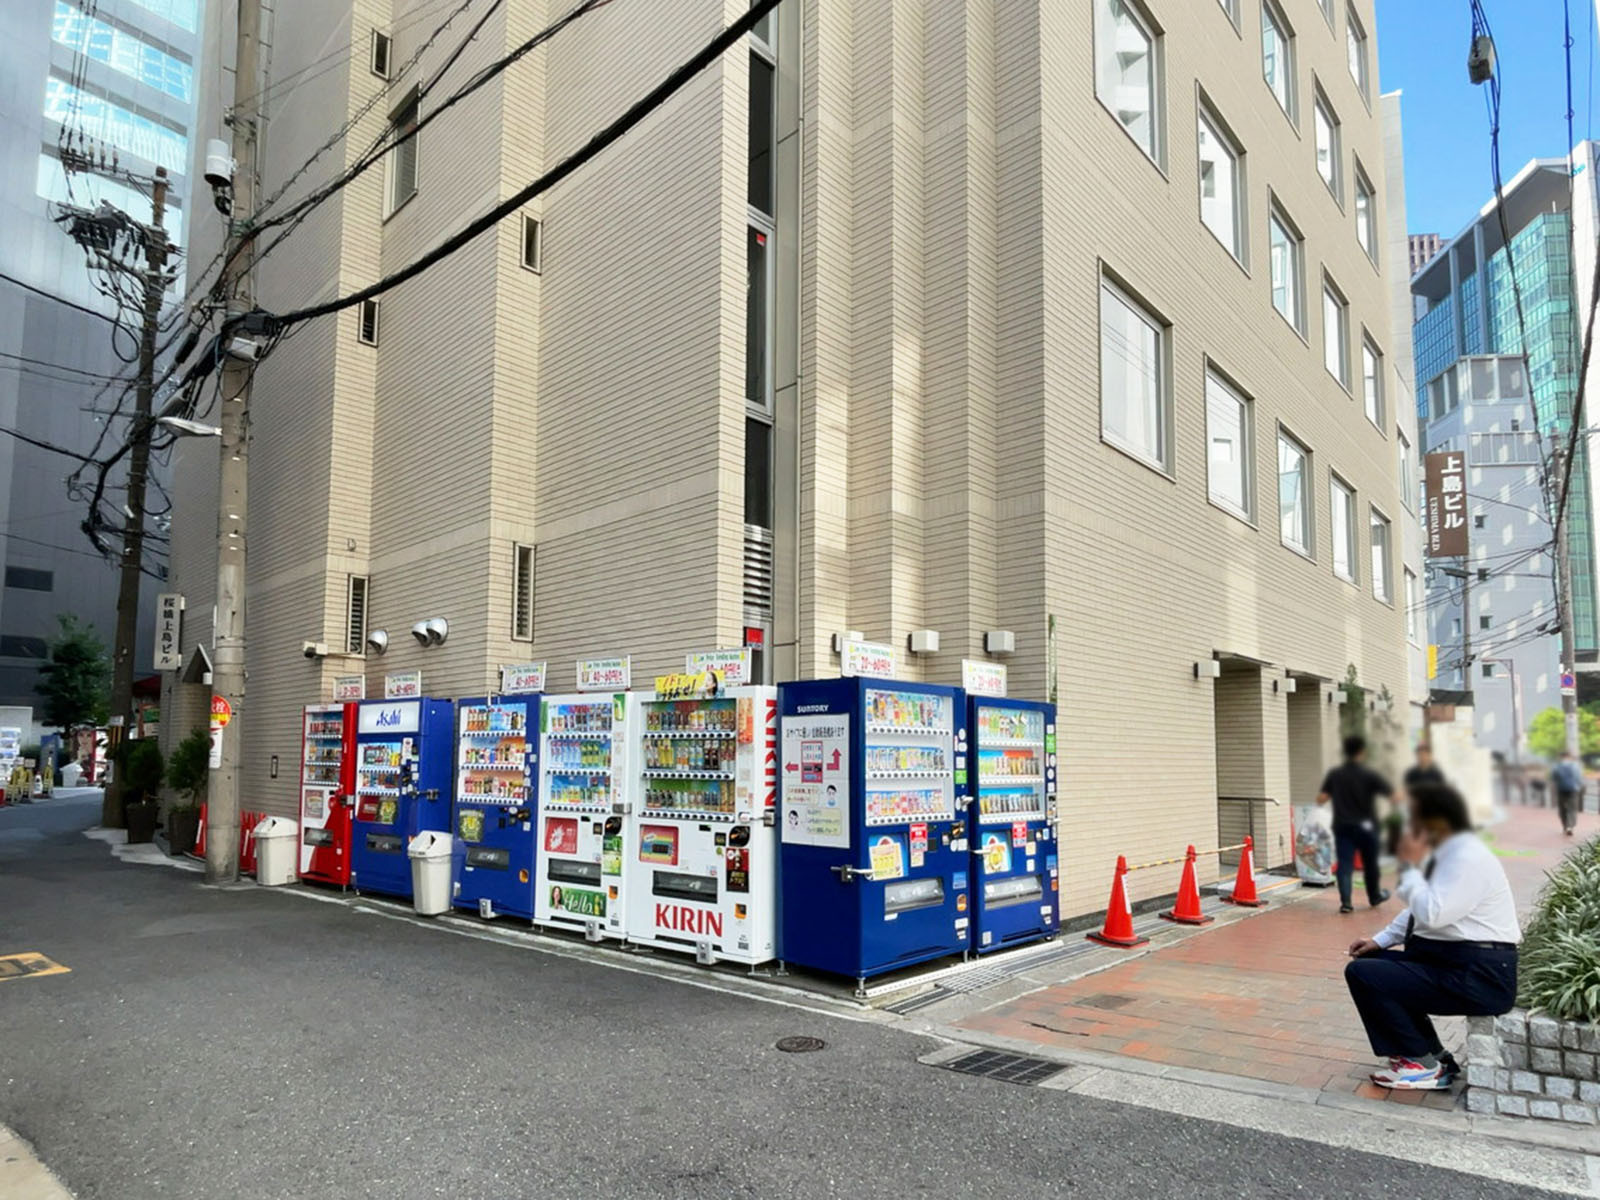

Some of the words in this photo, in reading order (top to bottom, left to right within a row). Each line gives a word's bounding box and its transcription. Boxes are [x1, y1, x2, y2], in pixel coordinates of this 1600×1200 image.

[1440, 456, 1465, 529] 上島ビル
[1429, 496, 1440, 534] UESHIMA
[160, 598, 175, 664] 桜橋上島ビル
[375, 708, 401, 727] Asahi
[796, 704, 829, 713] SUNTORY
[655, 903, 724, 938] KIRIN
